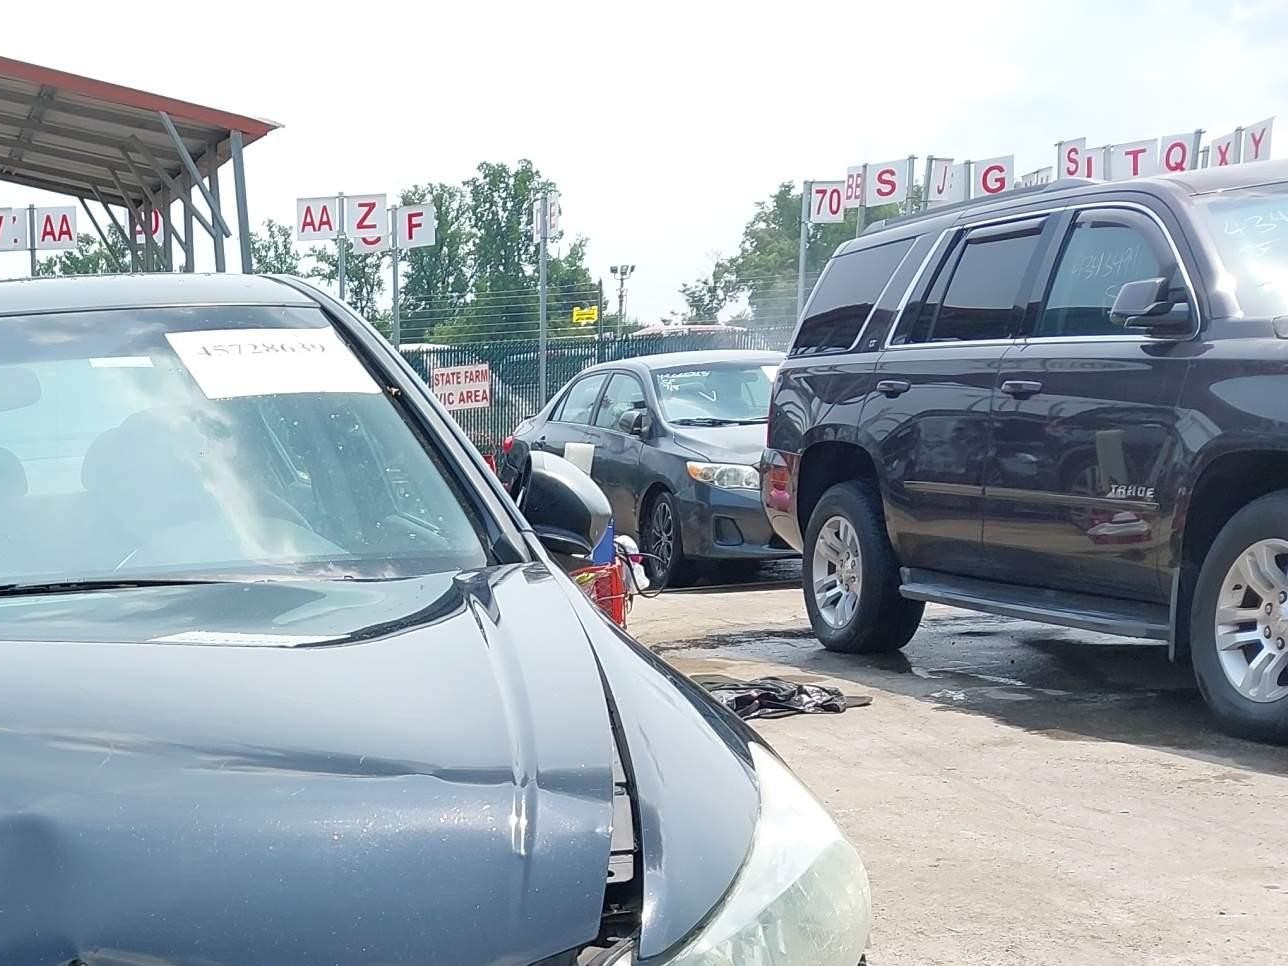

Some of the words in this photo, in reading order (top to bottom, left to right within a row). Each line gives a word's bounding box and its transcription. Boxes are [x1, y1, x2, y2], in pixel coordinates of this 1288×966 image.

[1165, 142, 1187, 171] Q
[1217, 141, 1231, 166] X
[1252, 127, 1266, 159] Y
[1066, 147, 1079, 176] S
[1125, 148, 1147, 176] T
[876, 169, 897, 197] S
[936, 165, 948, 195] J
[982, 165, 1006, 194] G
[356, 202, 377, 229] Z
[815, 188, 841, 216] 70
[41, 214, 73, 242] AA
[301, 204, 333, 233] AA
[407, 212, 424, 240] F
[434, 371, 461, 386] STATE
[464, 369, 488, 384] FARM
[458, 389, 489, 405] AREA
[1111, 484, 1155, 498] TAHOE
